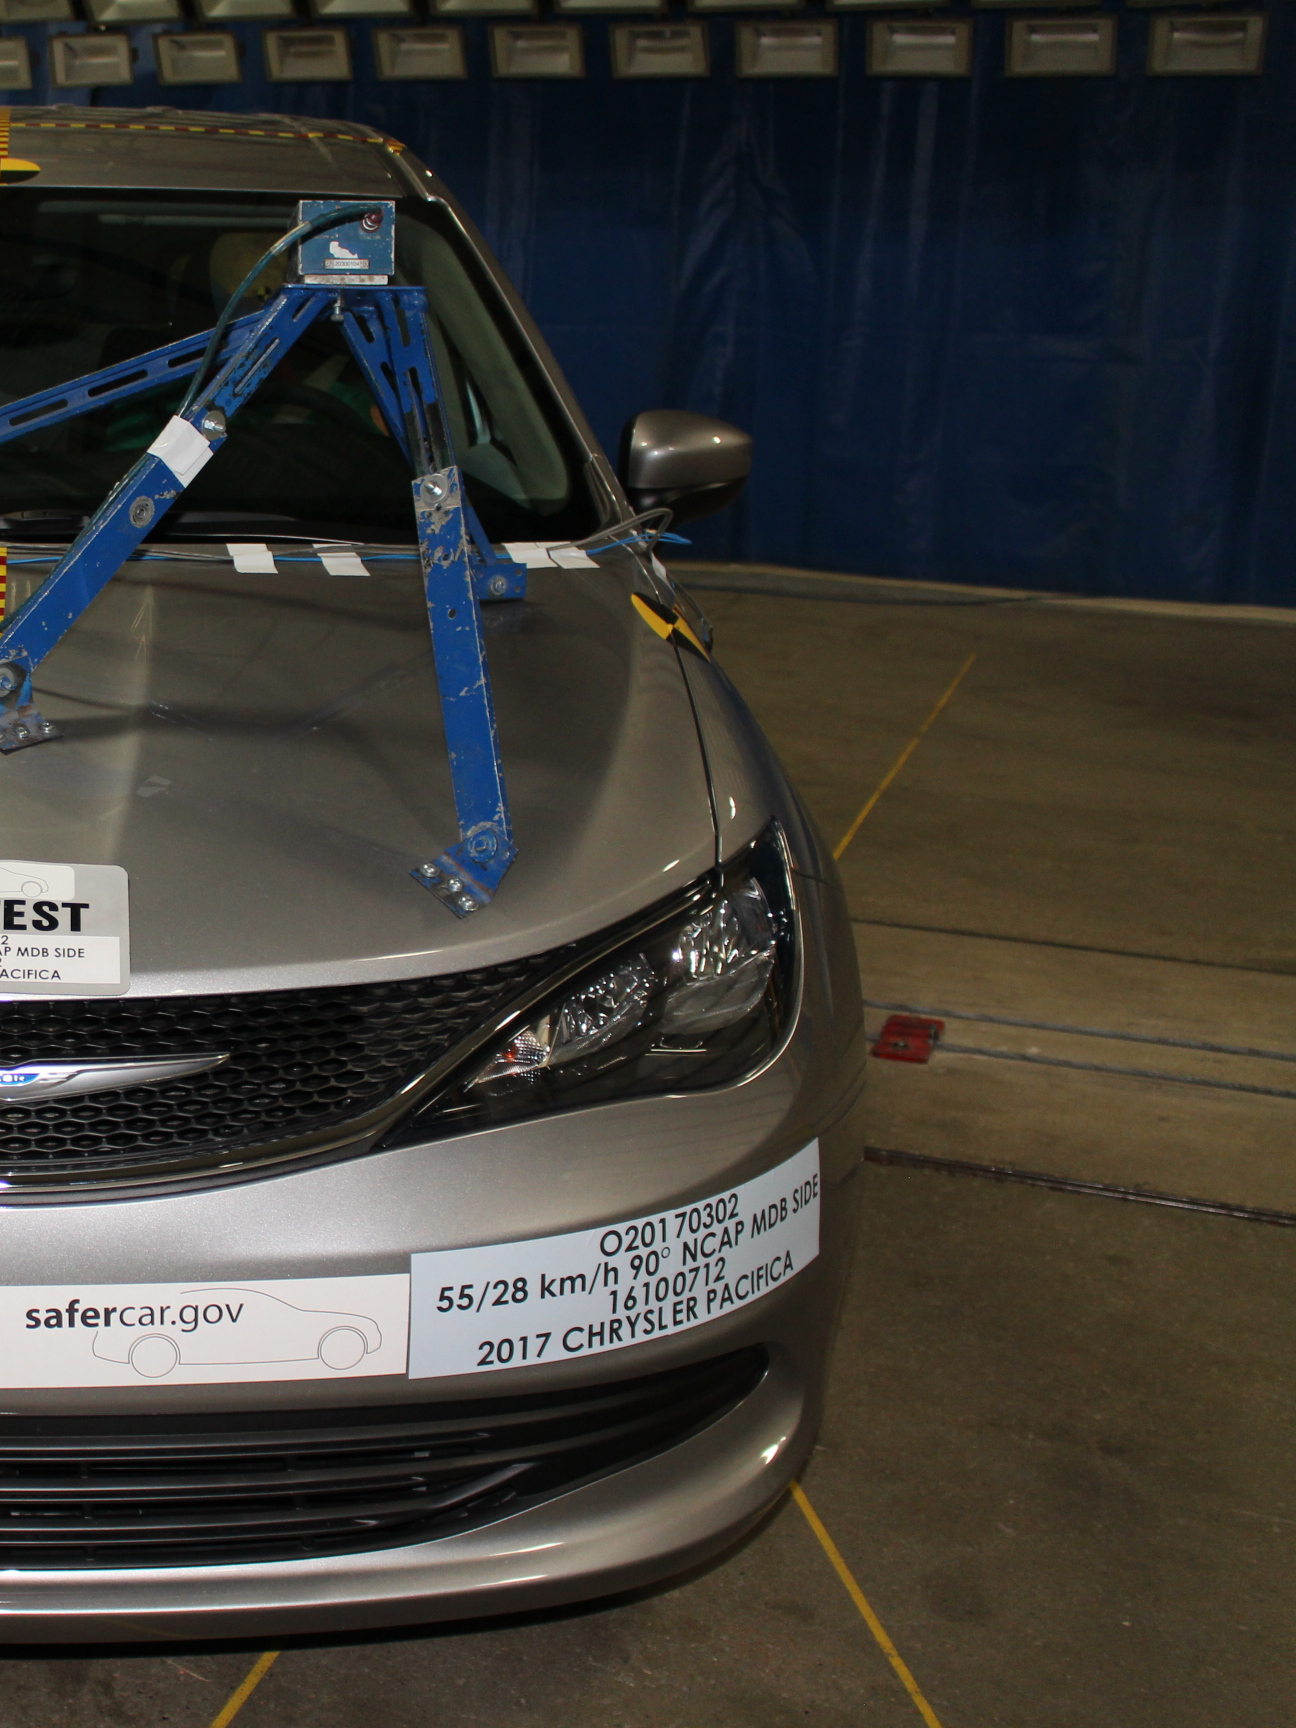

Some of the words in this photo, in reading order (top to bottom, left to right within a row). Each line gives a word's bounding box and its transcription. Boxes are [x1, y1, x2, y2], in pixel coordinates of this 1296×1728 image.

[16, 947, 50, 958] MDB
[53, 947, 85, 959] SIDE
[436, 1276, 529, 1314] 55/28
[540, 1262, 619, 1300] km/h
[682, 1219, 745, 1267] NCAP
[750, 1196, 789, 1240] MDB
[792, 1172, 820, 1214] SIDE
[599, 1192, 740, 1257] O20170302
[25, 1298, 245, 1333] safercar.gov
[476, 1332, 553, 1367] 2017
[562, 1295, 699, 1353] CHRYSLER
[706, 1249, 795, 1316] PACIFICA
[608, 1256, 727, 1316] 16100712
